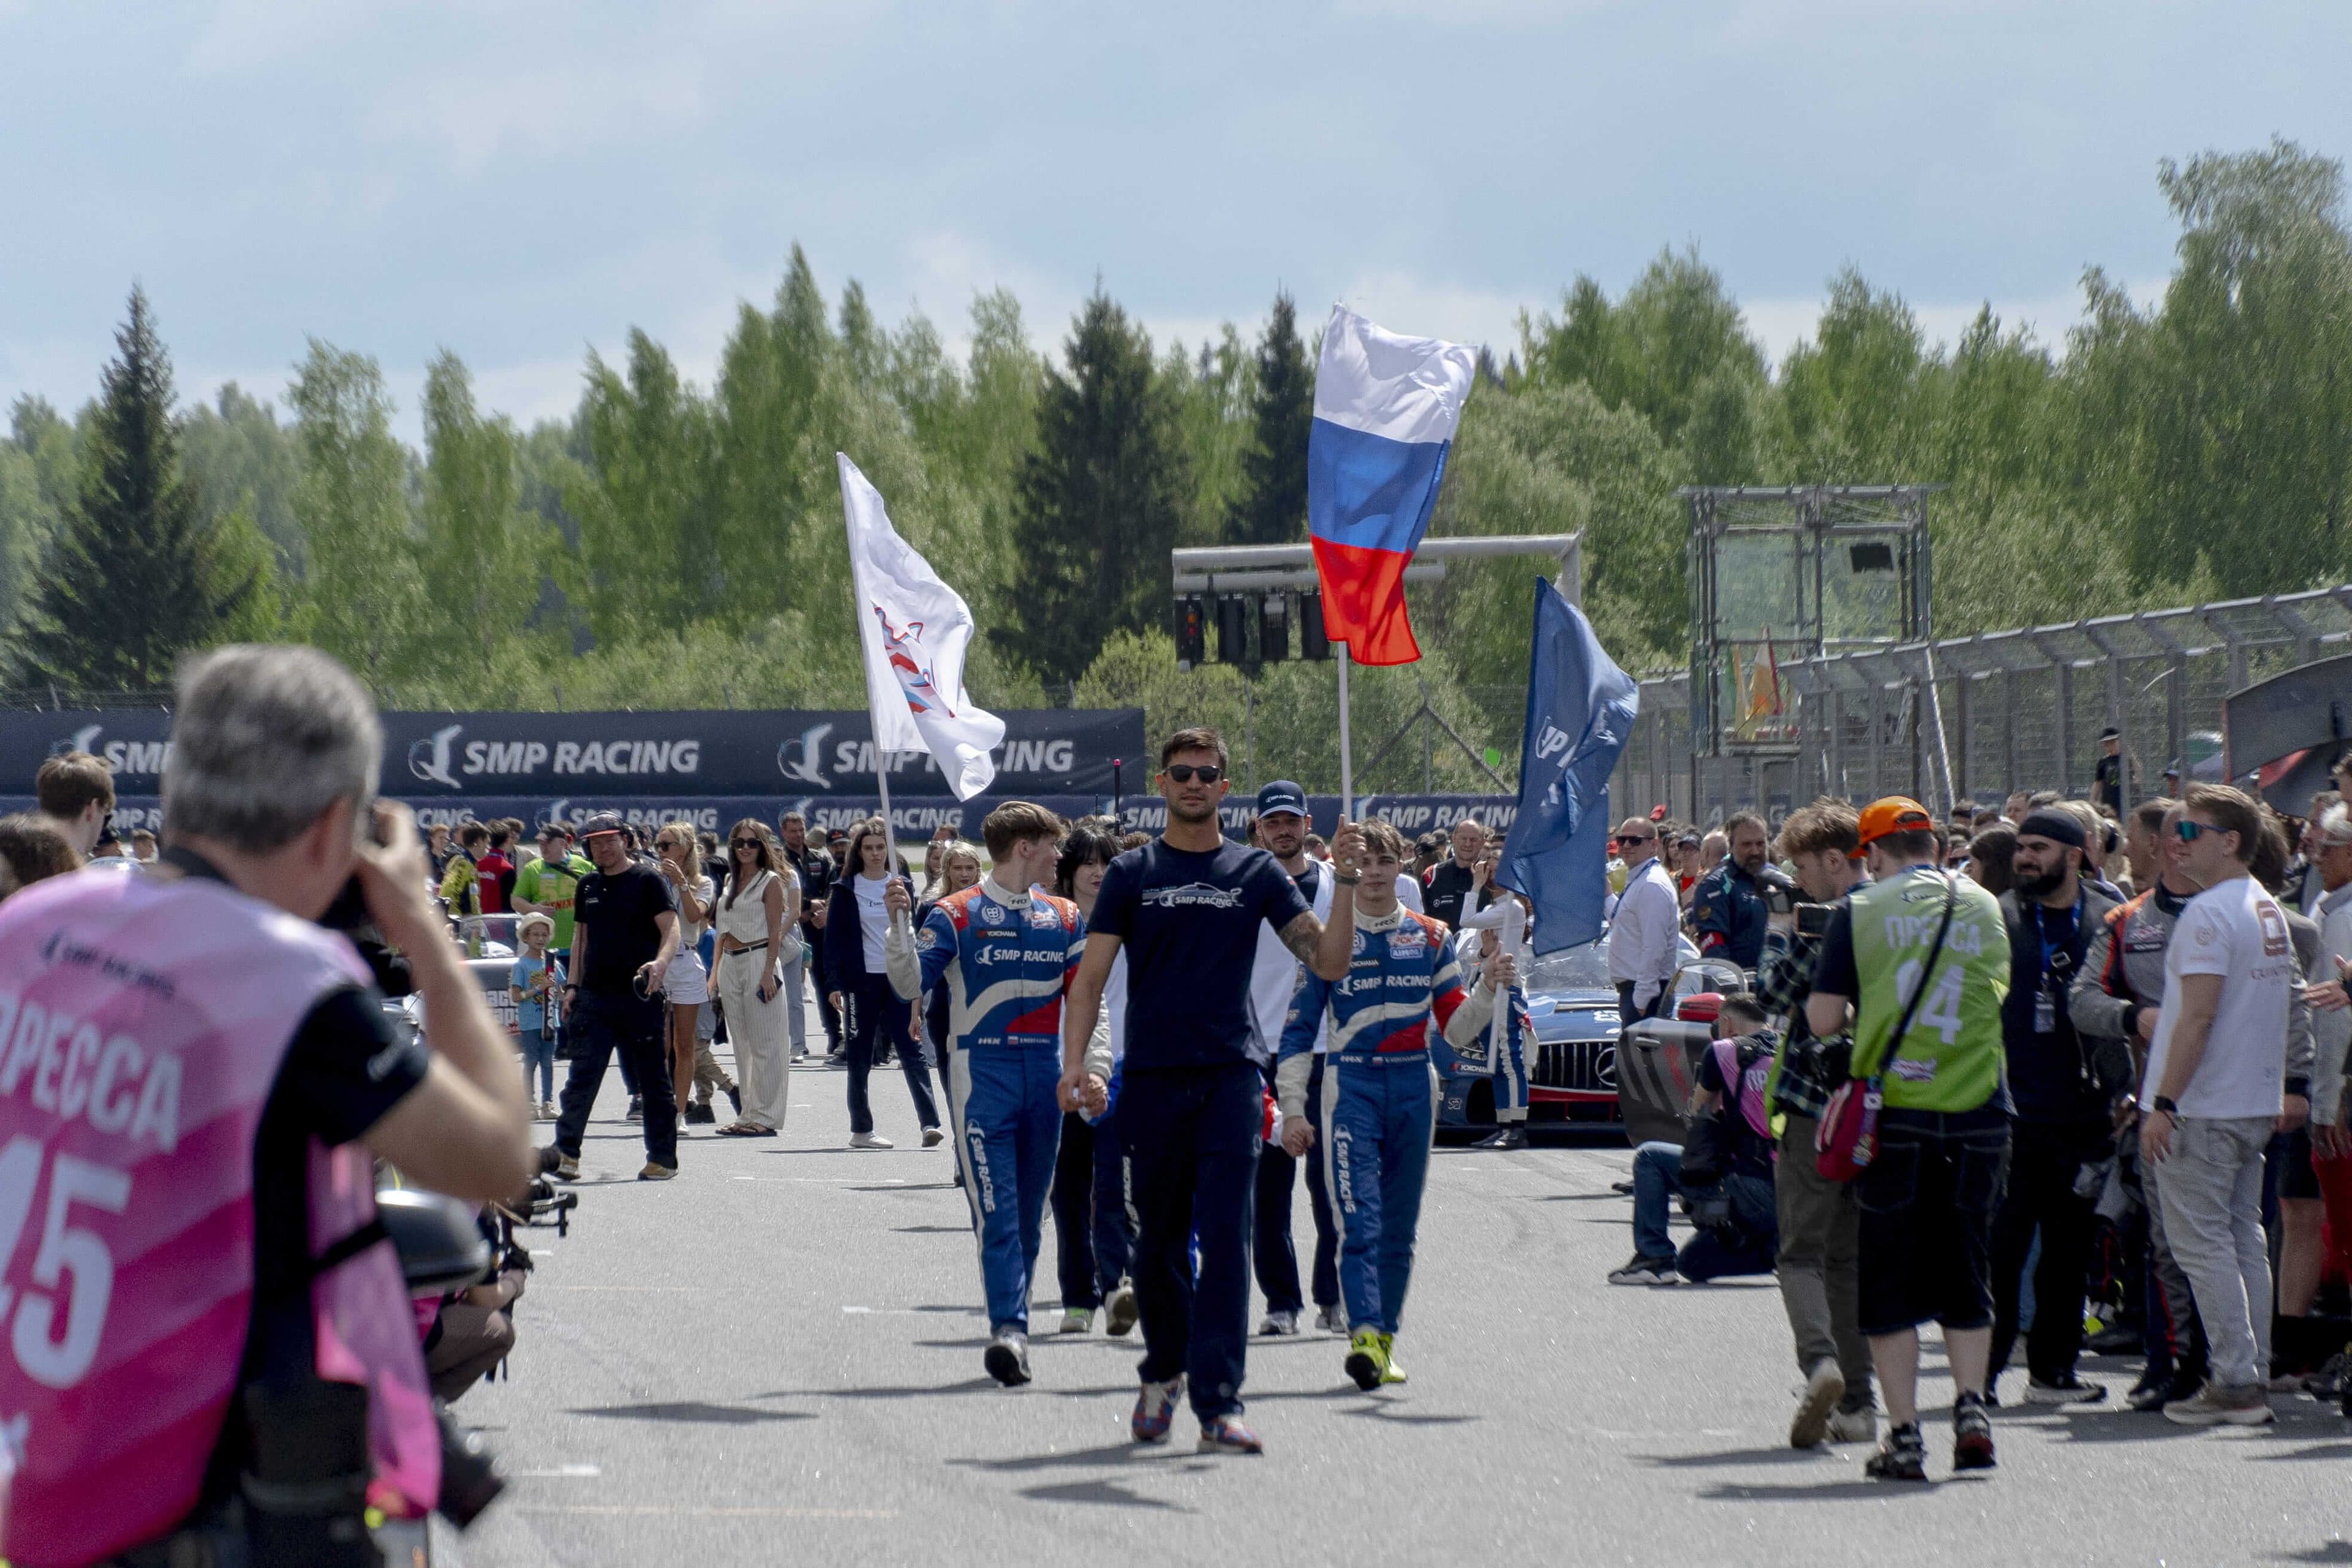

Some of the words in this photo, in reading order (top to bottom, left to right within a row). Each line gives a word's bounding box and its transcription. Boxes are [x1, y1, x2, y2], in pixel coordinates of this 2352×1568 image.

[462, 741, 548, 774] SMP
[553, 741, 699, 774] RACING
[1377, 806, 1431, 828] SMP
[1175, 896, 1196, 905] SMP
[1197, 897, 1233, 907] RACING
[993, 949, 1021, 961] SMP
[1023, 951, 1064, 962] RACING
[1350, 959, 1379, 968] OKOHAMA
[1353, 976, 1382, 991] SMP
[1386, 975, 1431, 987] RACING
